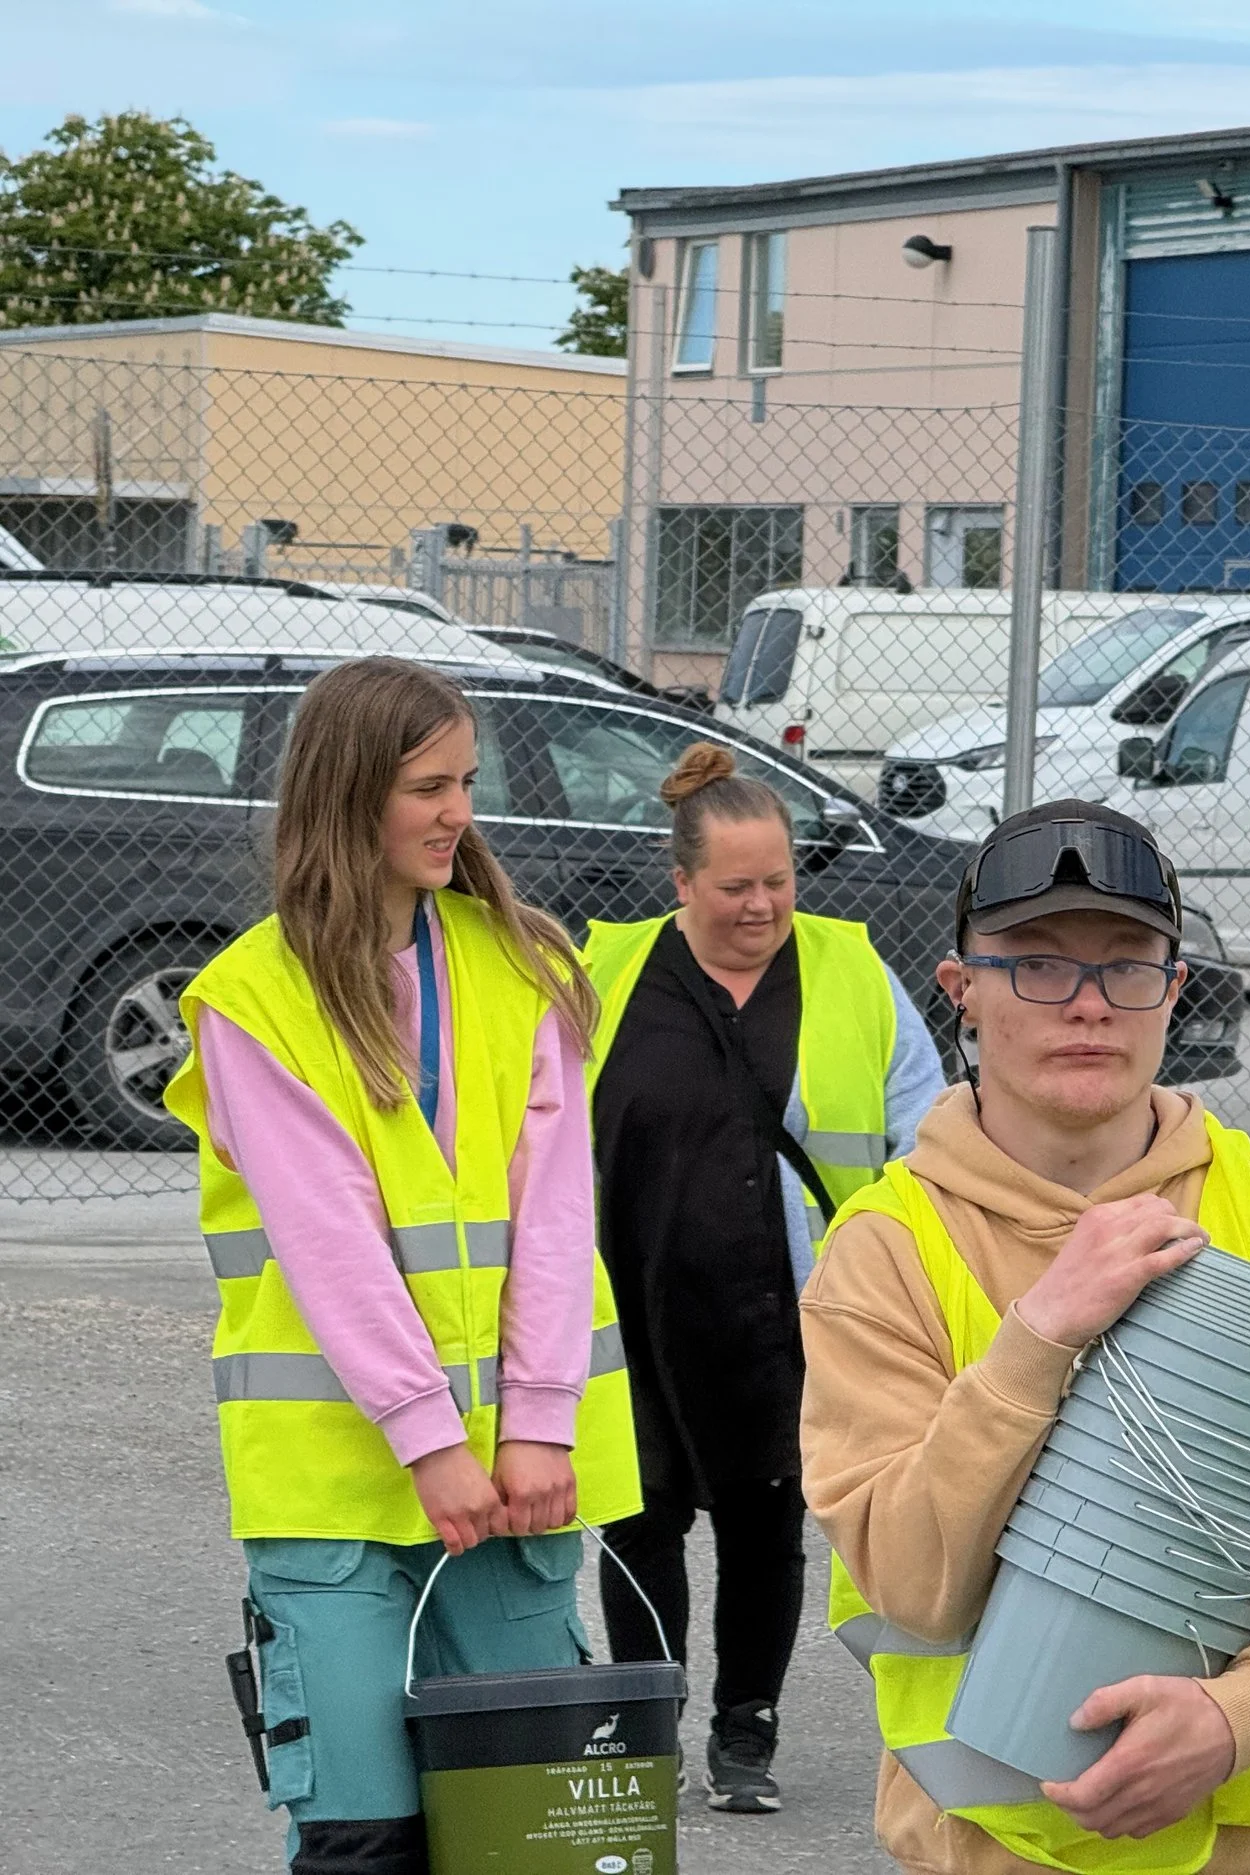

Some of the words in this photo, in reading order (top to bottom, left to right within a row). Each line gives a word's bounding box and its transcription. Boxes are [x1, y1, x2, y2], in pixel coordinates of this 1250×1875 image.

[583, 1742, 627, 1756] ALCRO
[568, 1775, 641, 1800] VILLA
[547, 1804, 607, 1817] HALVMATT
